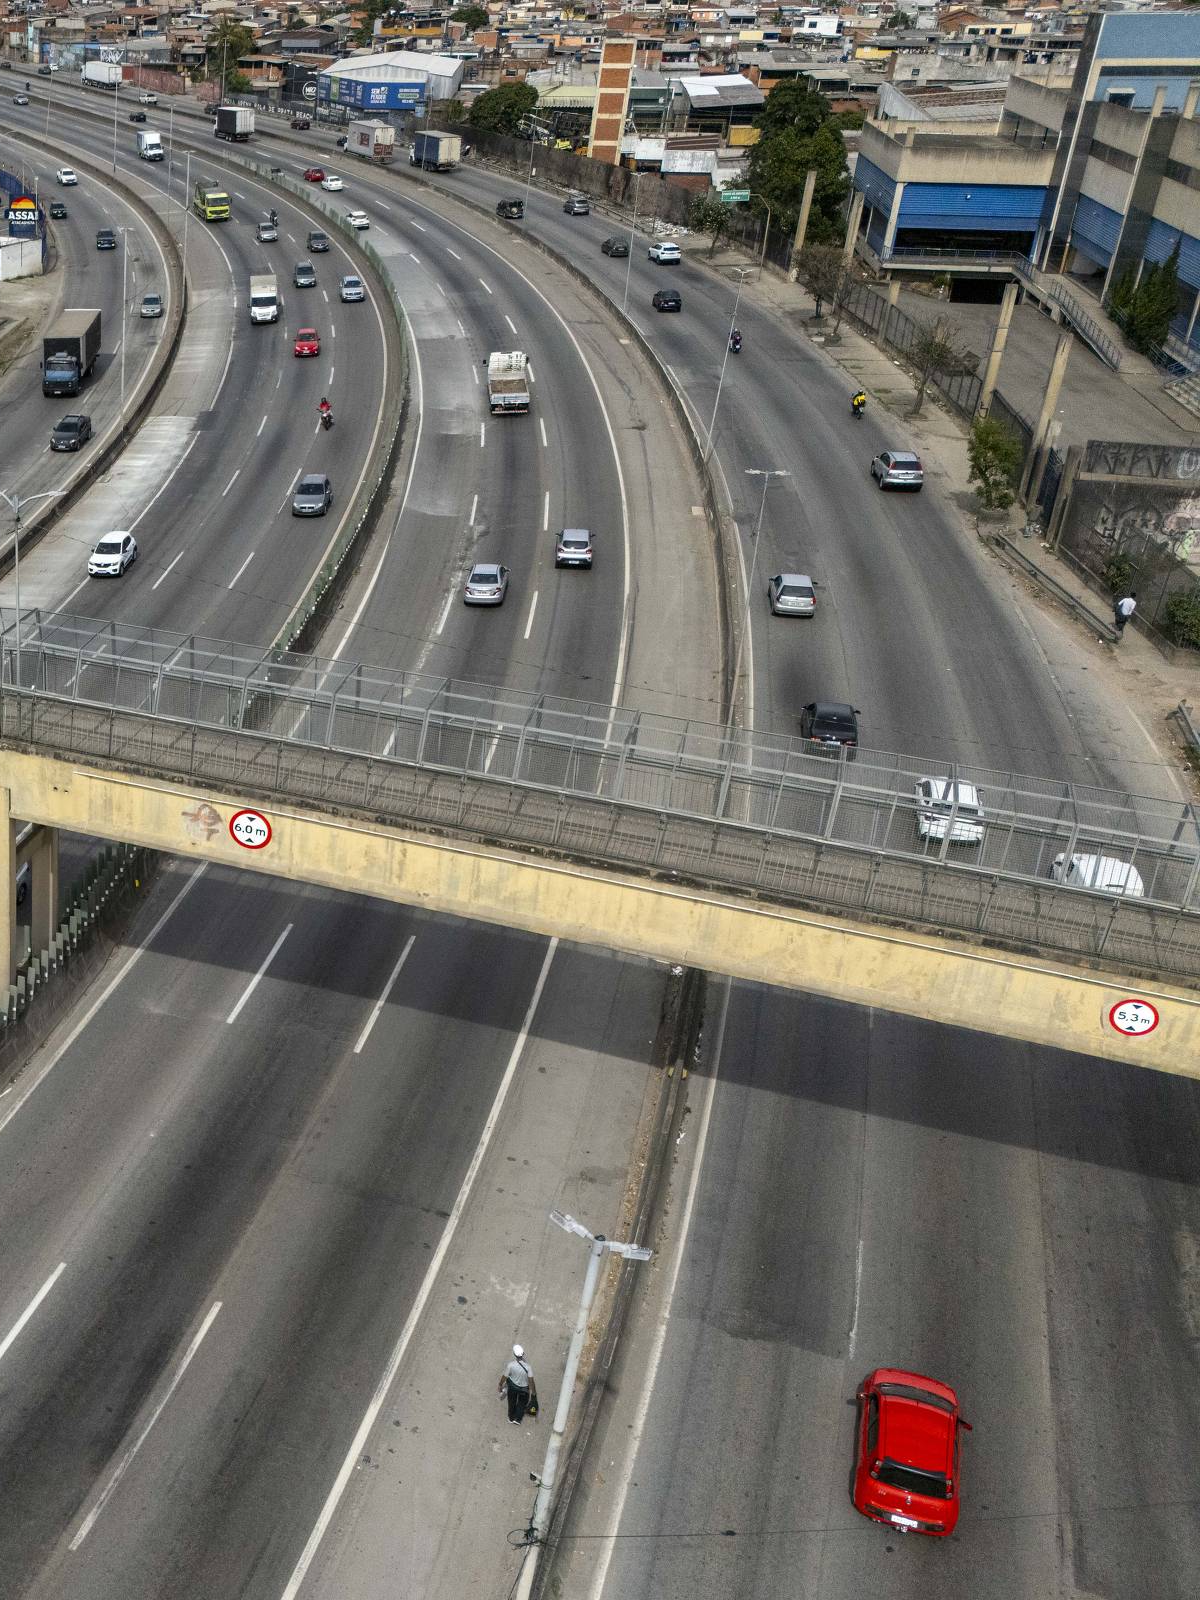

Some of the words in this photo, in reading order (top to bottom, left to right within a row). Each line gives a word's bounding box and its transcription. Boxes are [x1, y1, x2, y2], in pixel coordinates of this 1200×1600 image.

[295, 111, 314, 120] BEACH
[235, 824, 253, 834] 6.0
[256, 828, 266, 837] m
[1118, 1011, 1139, 1022] 5,3
